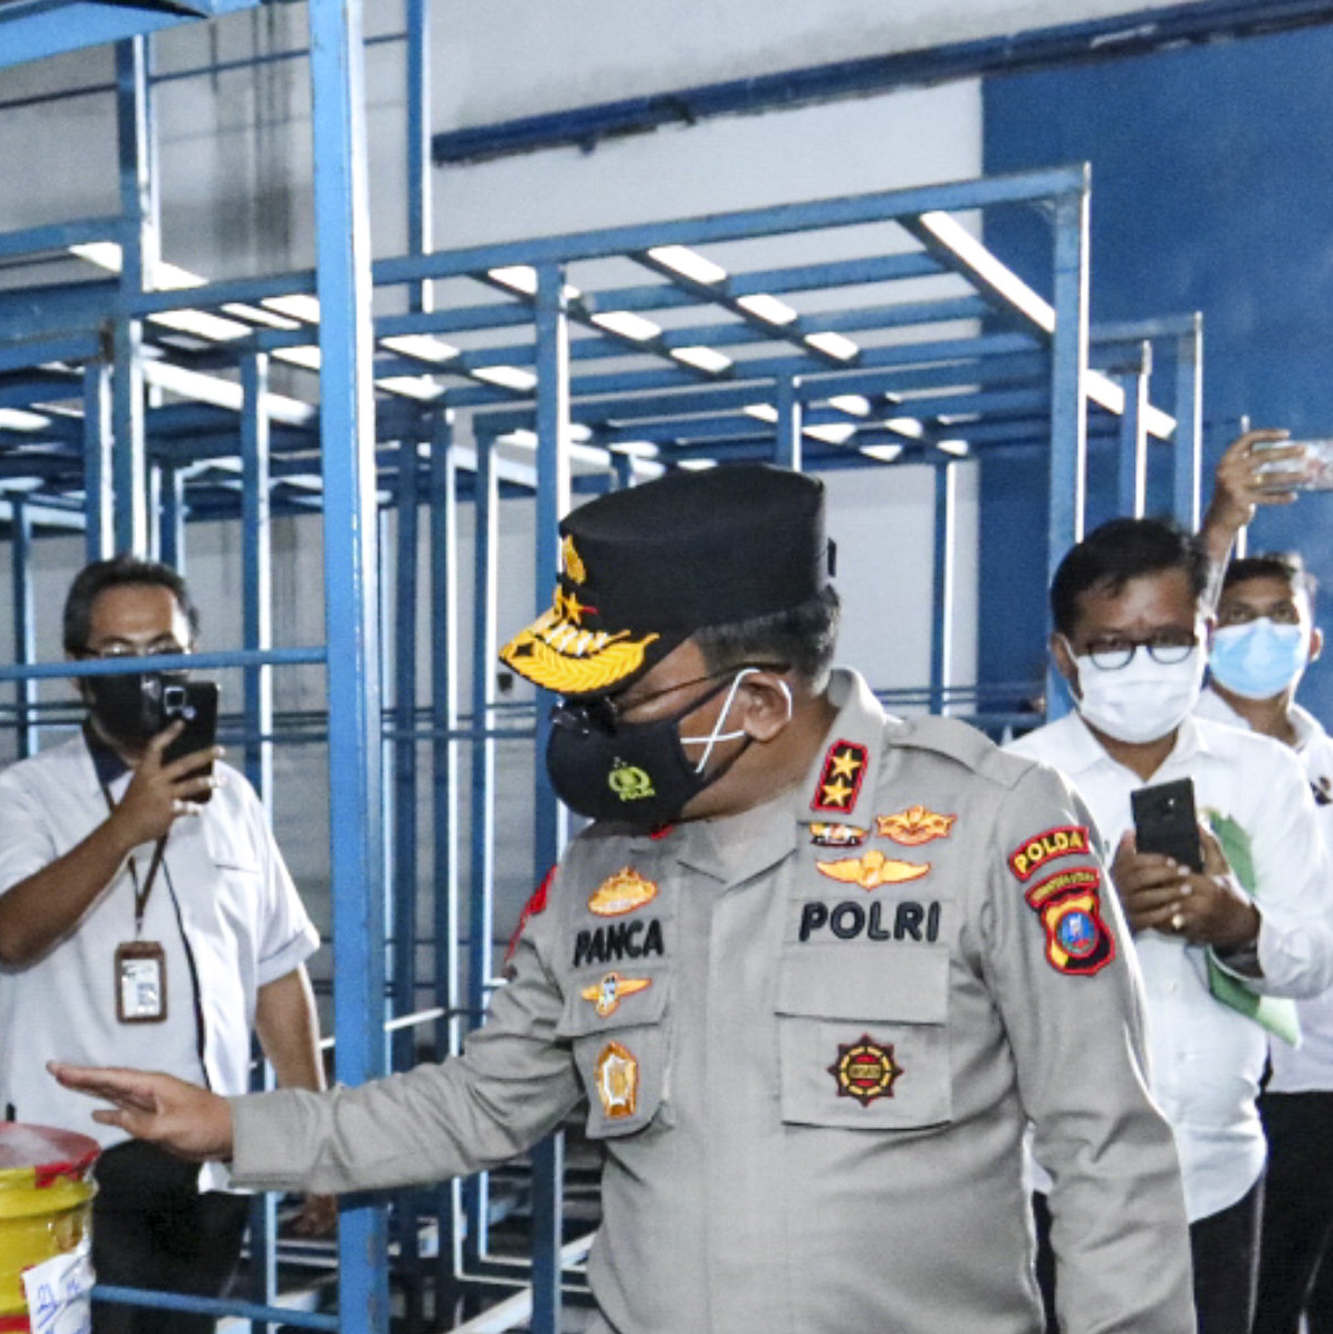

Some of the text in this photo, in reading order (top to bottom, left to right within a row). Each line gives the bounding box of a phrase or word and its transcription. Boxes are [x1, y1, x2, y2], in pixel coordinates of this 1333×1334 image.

[1014, 831, 1084, 874] POLDA
[573, 919, 664, 967] PANCA
[798, 901, 941, 942] POLRI
